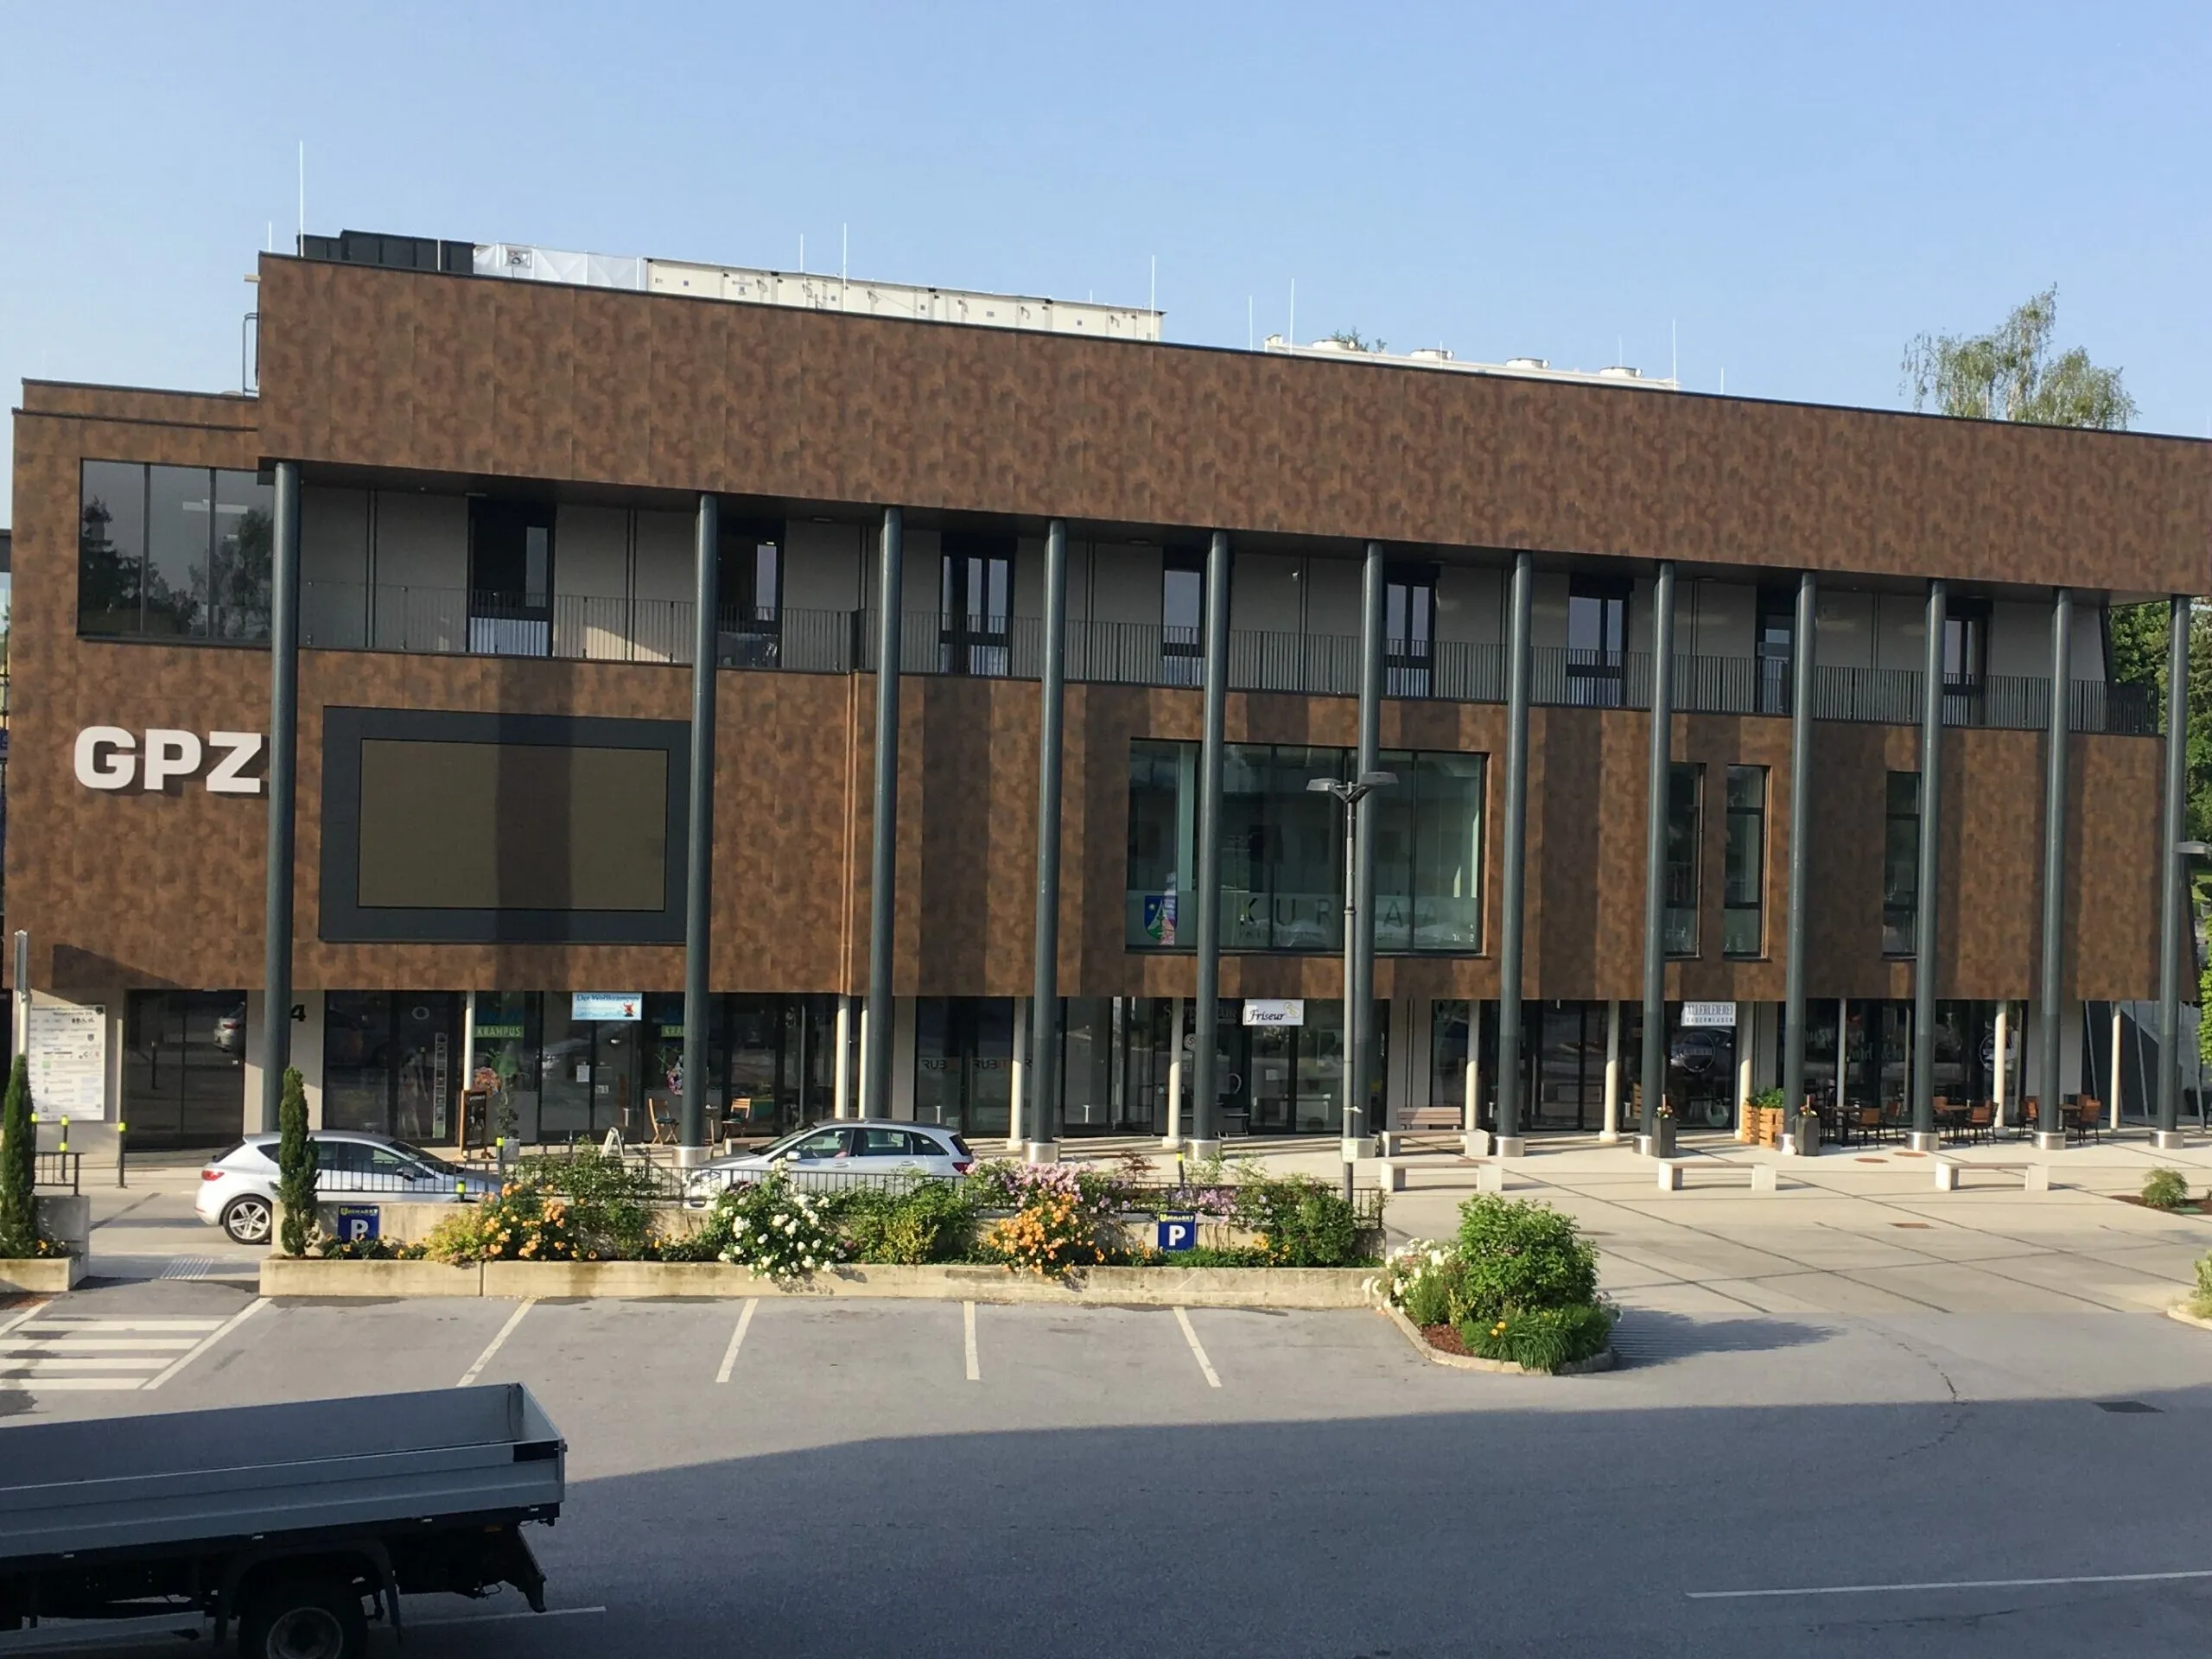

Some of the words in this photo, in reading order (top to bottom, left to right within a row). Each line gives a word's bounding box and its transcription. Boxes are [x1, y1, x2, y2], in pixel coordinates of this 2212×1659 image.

[74, 725, 262, 793] GPZ
[290, 1004, 306, 1021] 4
[1247, 1008, 1286, 1022] Friseur
[476, 1026, 522, 1037] KRAMPUS
[664, 1026, 684, 1037] KRA
[351, 1219, 369, 1241] P
[1168, 1224, 1186, 1246] P
